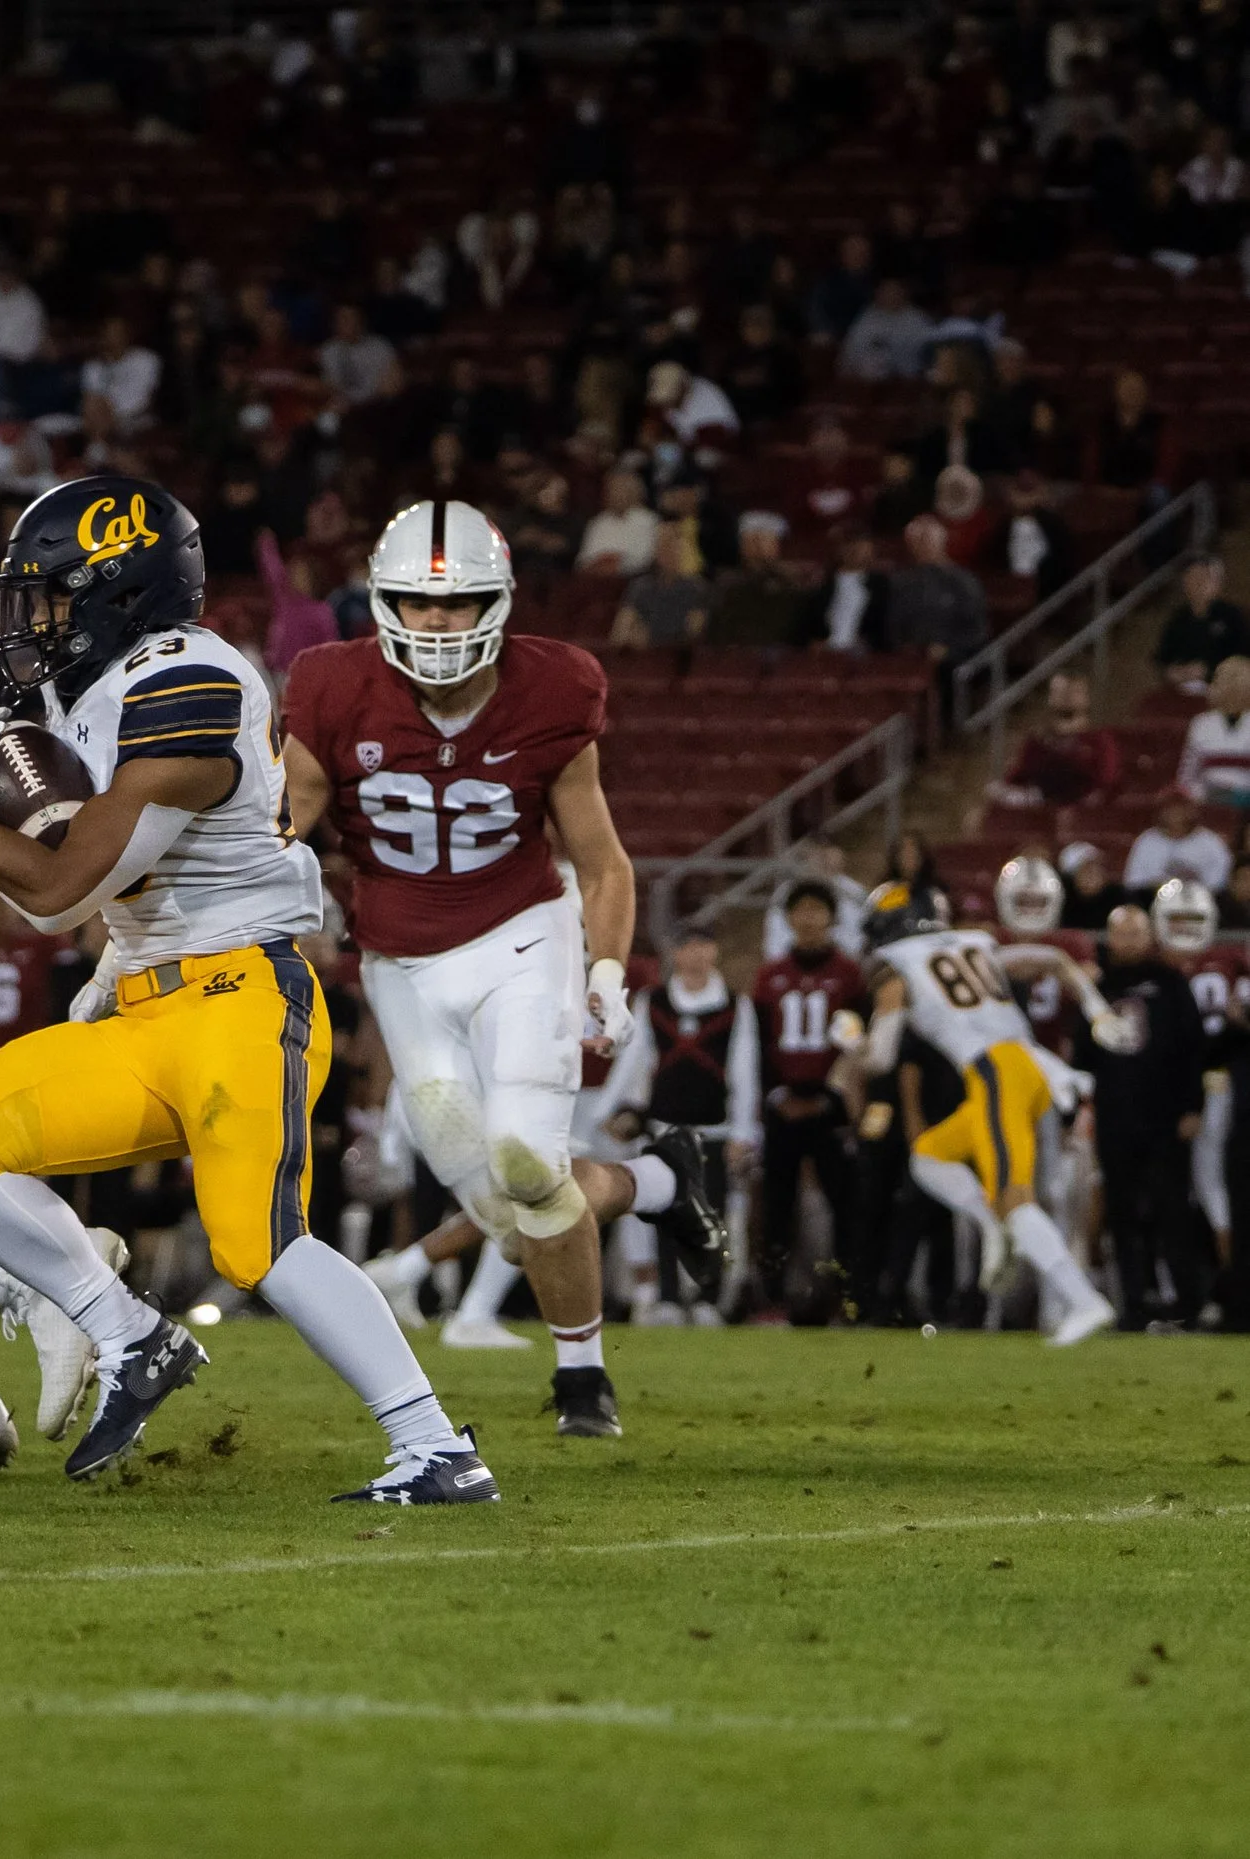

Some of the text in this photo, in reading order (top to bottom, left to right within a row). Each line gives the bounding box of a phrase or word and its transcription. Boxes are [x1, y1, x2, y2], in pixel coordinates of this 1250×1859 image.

[77, 493, 160, 566] Cal
[358, 771, 521, 874] 92
[203, 972, 246, 997] Cal
[930, 948, 1014, 1009] 80
[779, 989, 829, 1051] 11
